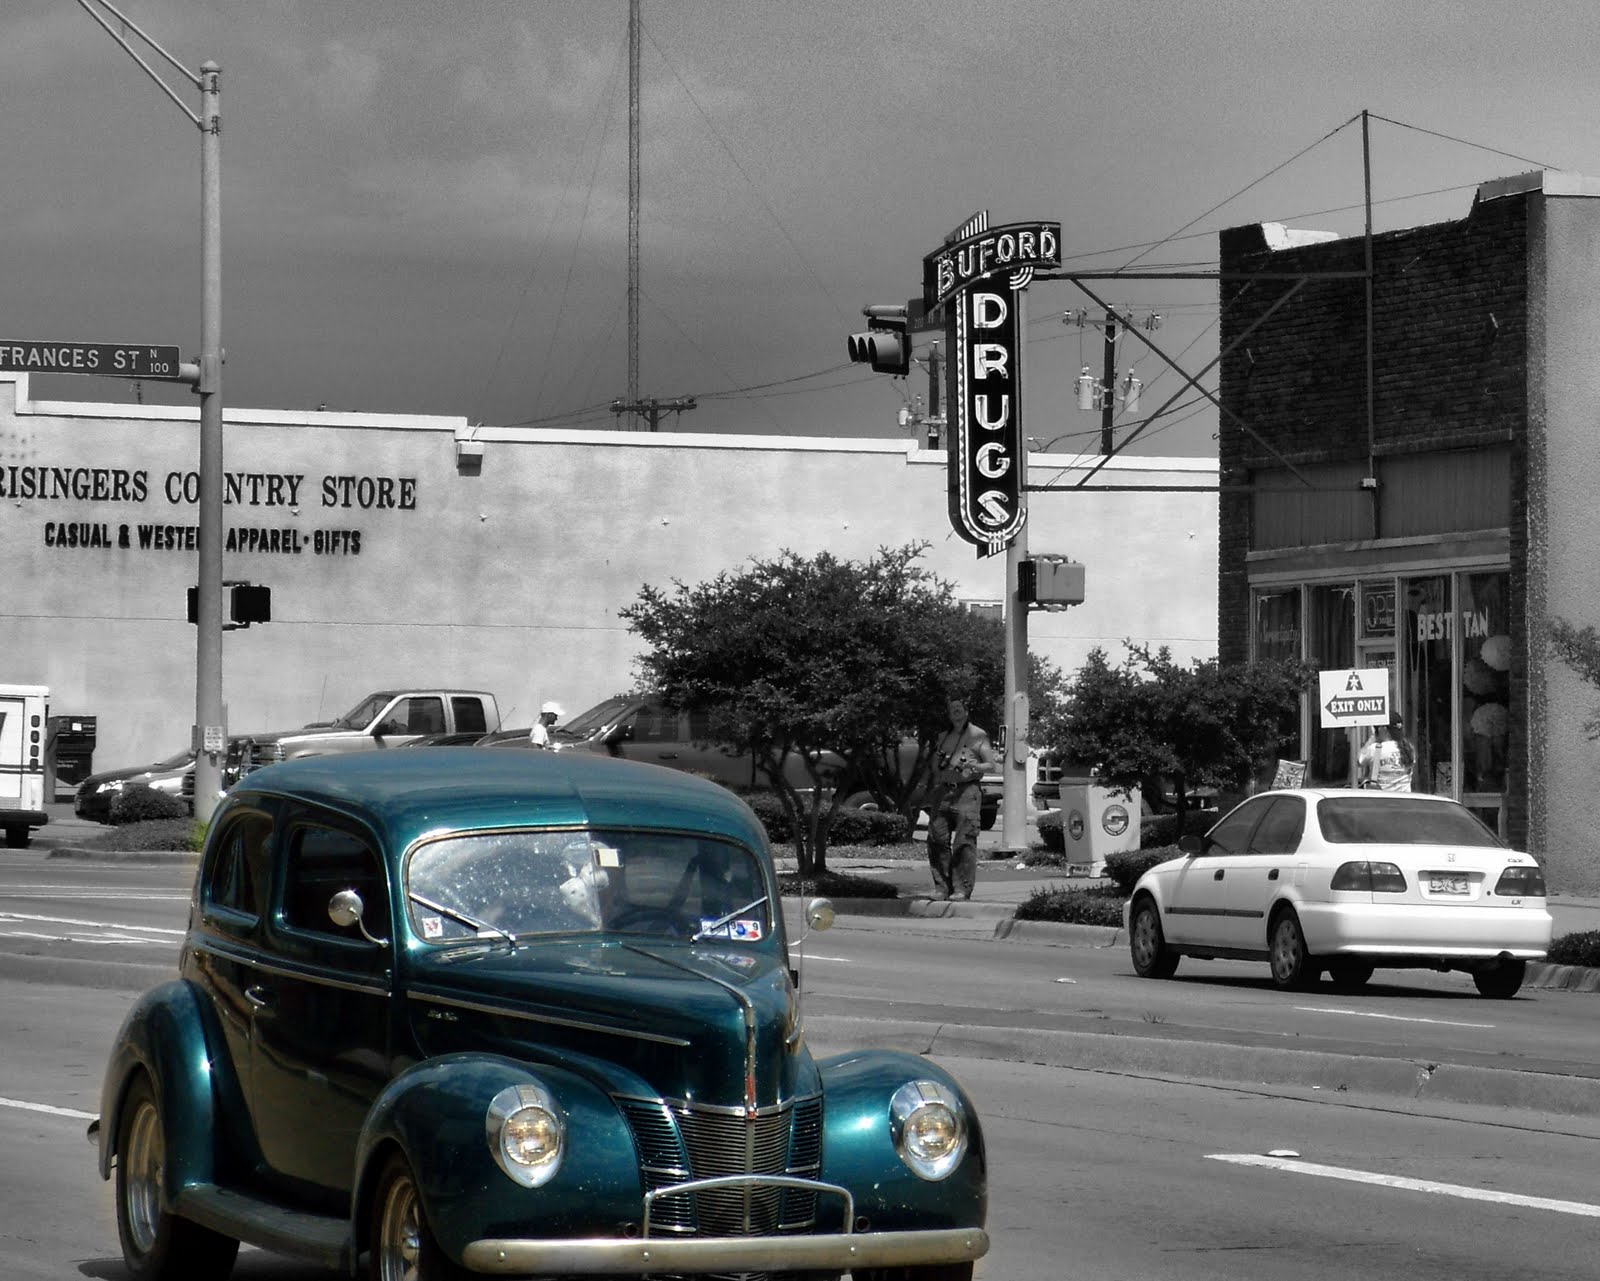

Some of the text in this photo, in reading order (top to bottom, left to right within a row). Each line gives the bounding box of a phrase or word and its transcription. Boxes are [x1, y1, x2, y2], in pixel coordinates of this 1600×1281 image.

[937, 229, 1057, 298] BUFORD
[0, 346, 140, 369] FRANCES ST
[150, 349, 158, 359] N
[150, 363, 169, 373] 100
[973, 293, 1011, 526] DRUGS
[165, 470, 305, 507] CONTRY
[321, 475, 417, 510] STORE
[44, 521, 112, 549] CASUAL
[118, 524, 130, 549] &
[137, 524, 200, 551] WESTE
[1367, 594, 1396, 628] OPE
[1417, 606, 1488, 641] BEST TAN
[1330, 699, 1383, 713] EXIT ONLY
